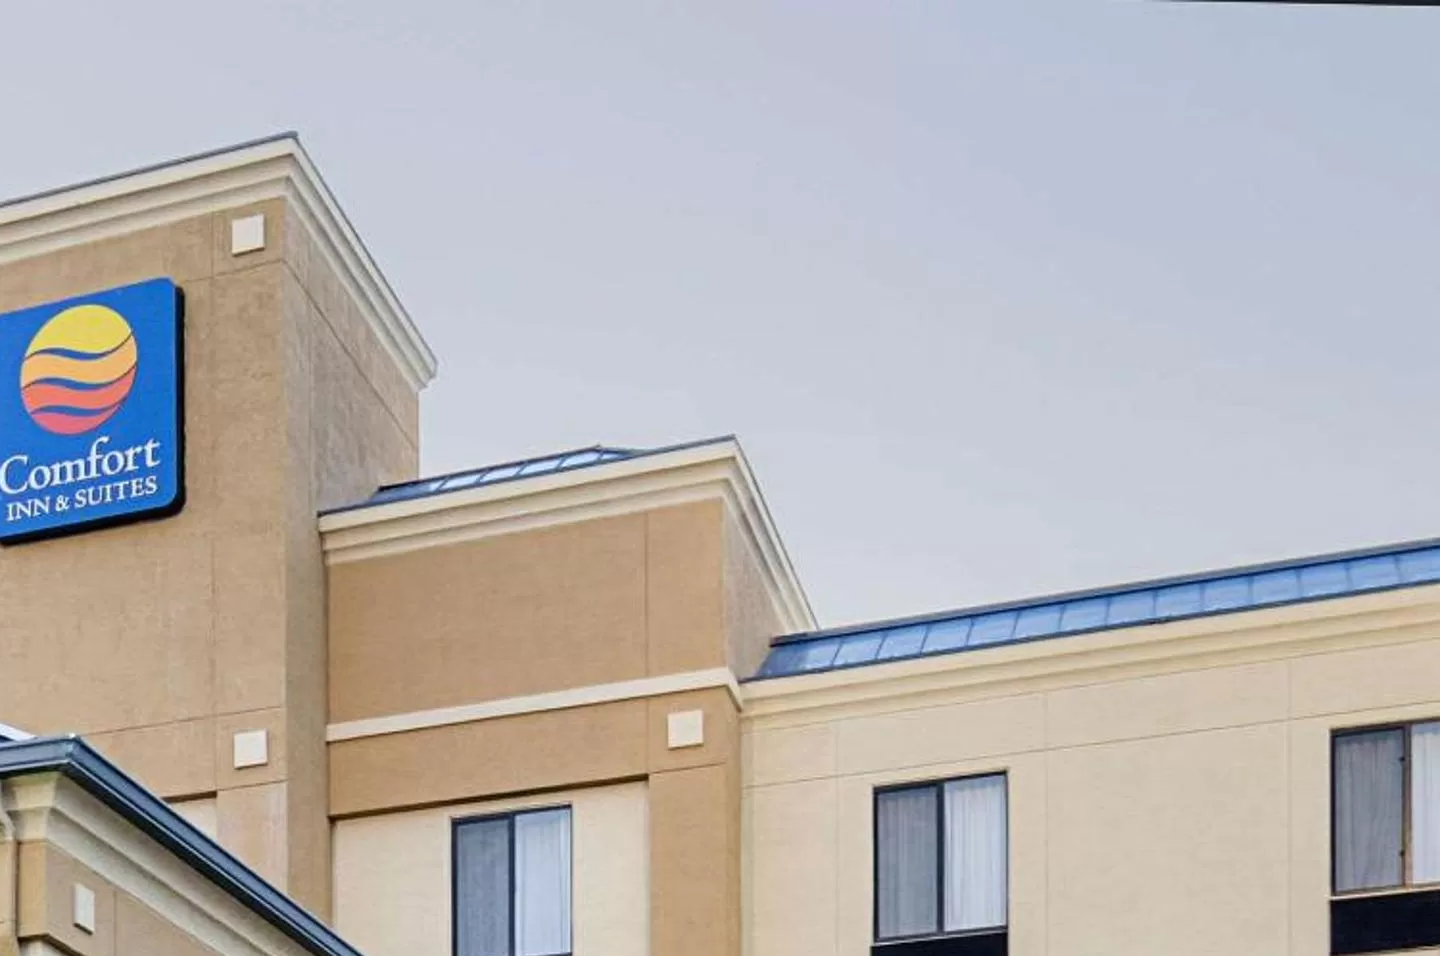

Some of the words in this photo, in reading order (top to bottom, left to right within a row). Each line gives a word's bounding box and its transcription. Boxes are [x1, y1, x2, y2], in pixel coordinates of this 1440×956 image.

[6, 495, 50, 521] INN
[55, 495, 70, 512] &
[74, 475, 158, 508] SUITES
